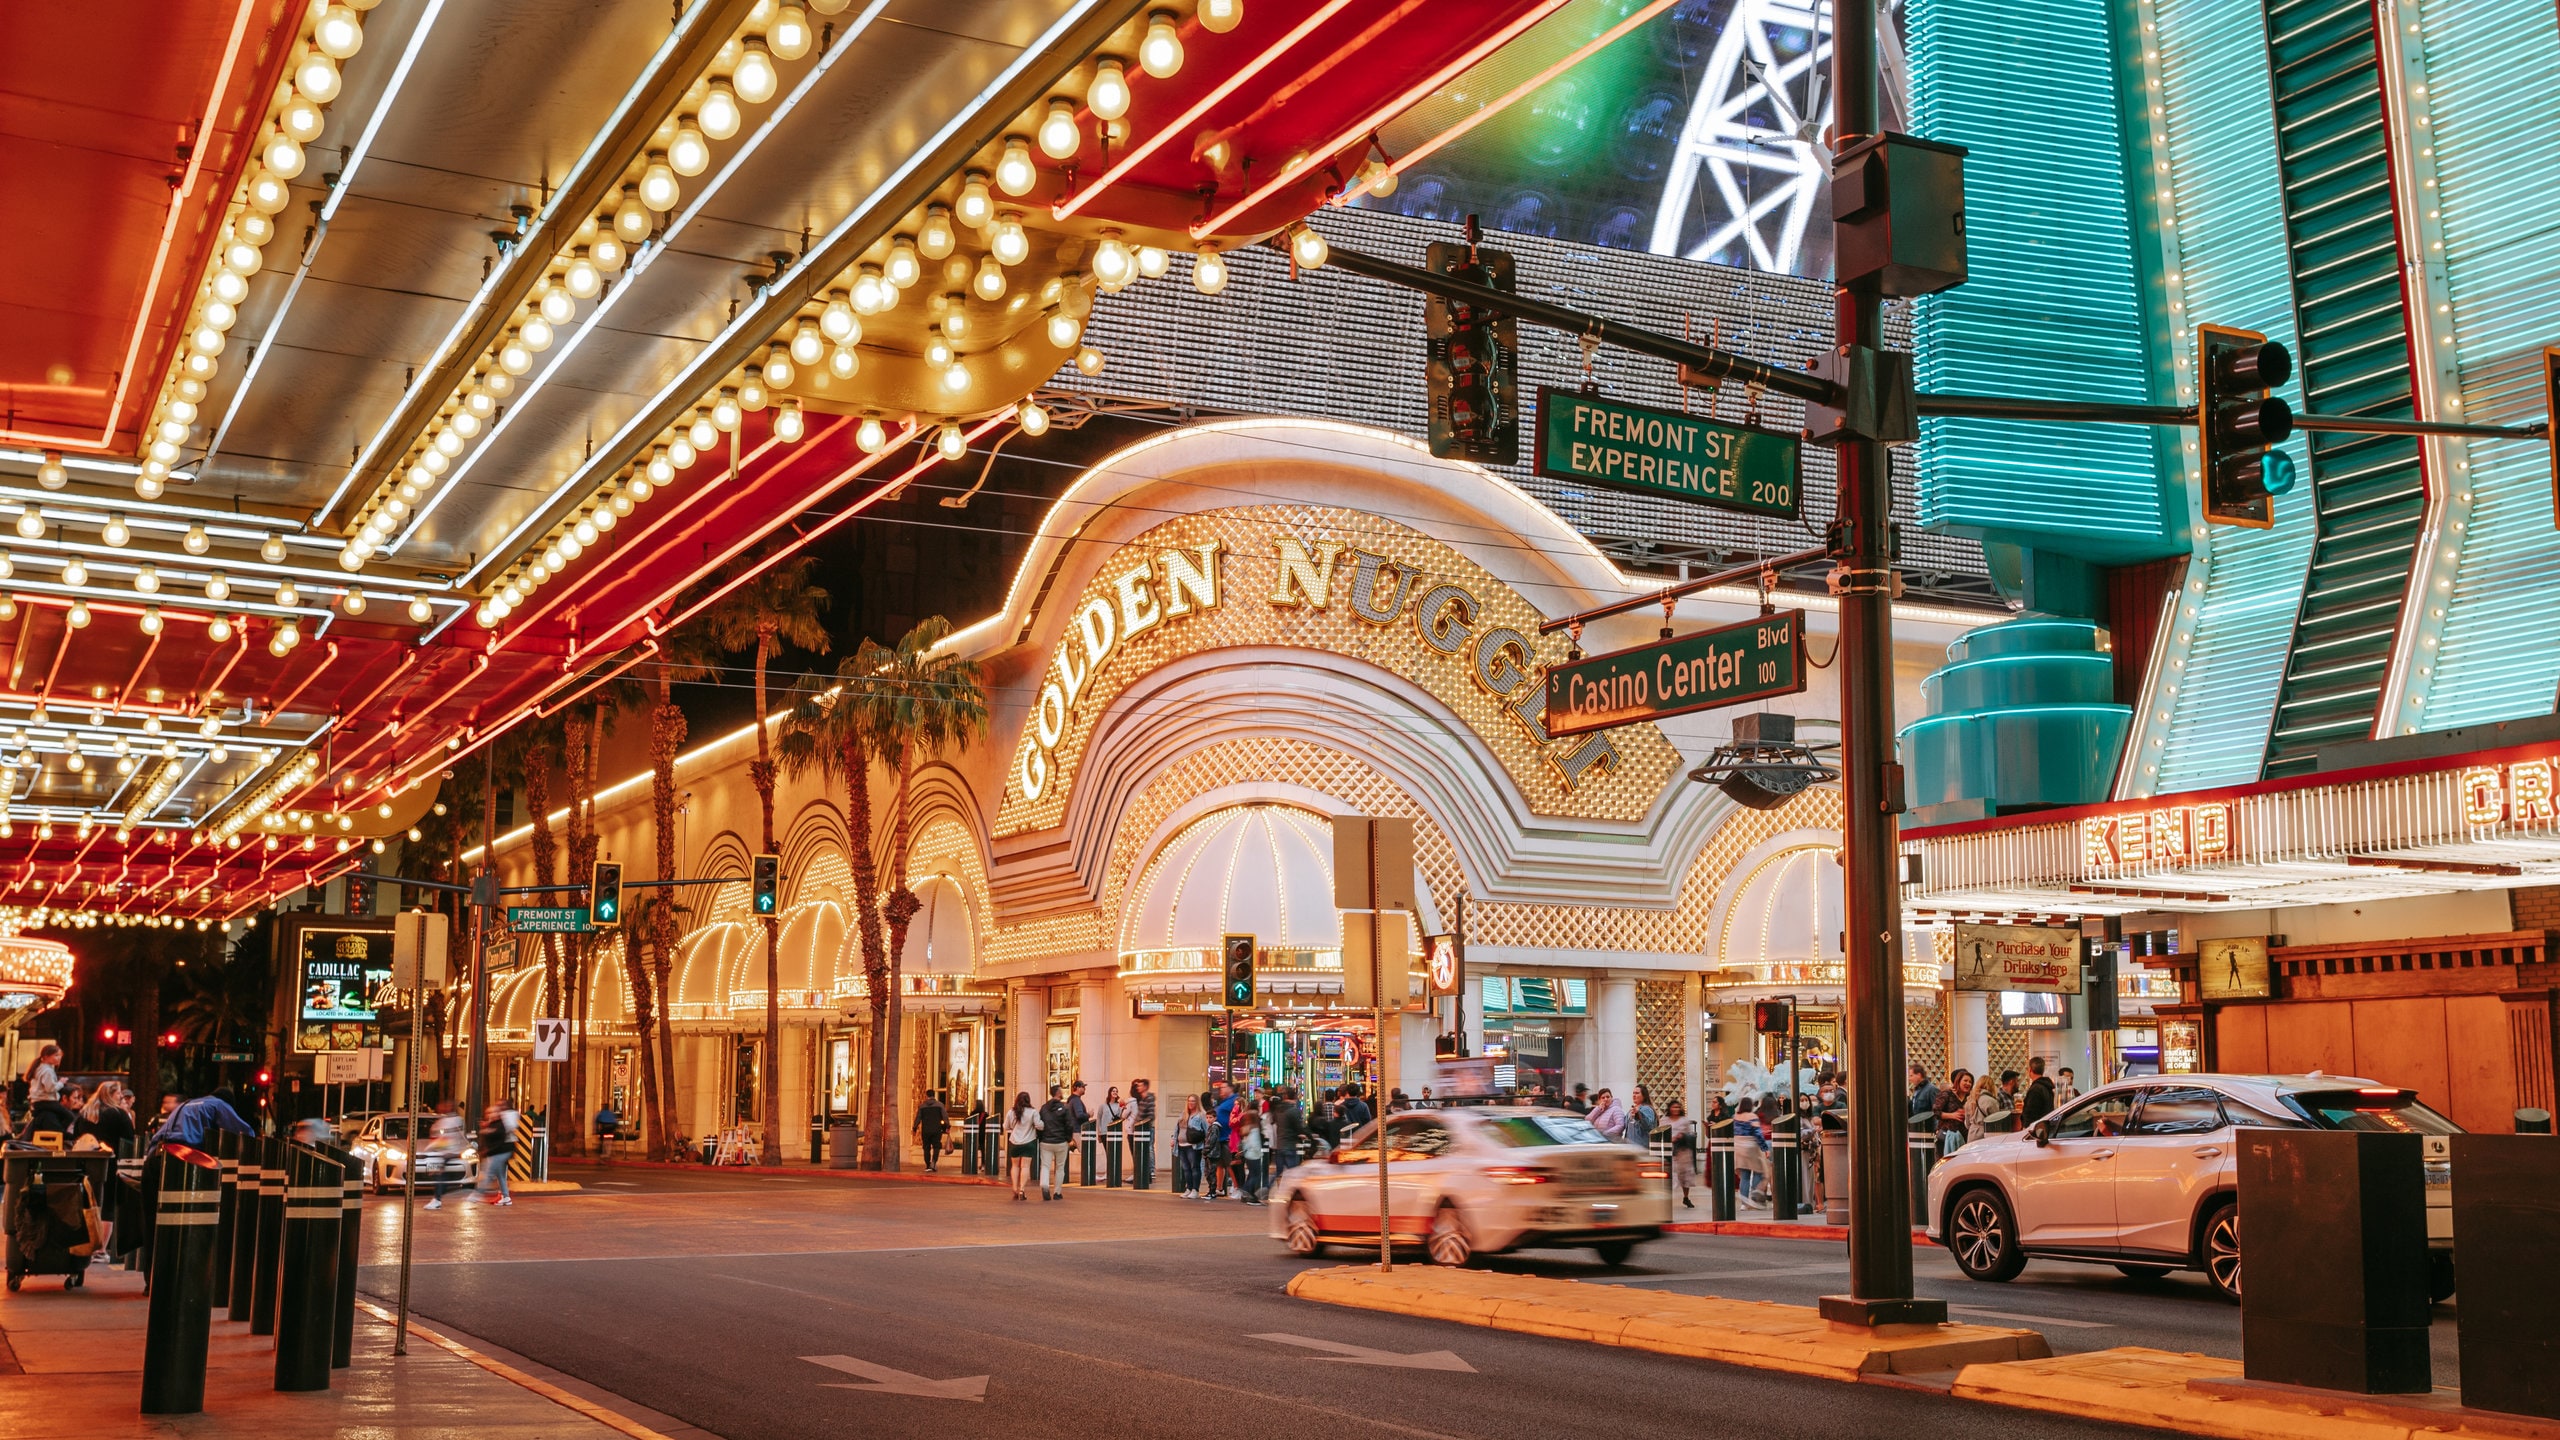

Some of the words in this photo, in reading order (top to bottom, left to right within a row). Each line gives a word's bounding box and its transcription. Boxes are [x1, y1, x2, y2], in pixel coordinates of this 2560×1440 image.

[1573, 405, 1699, 454] FREMONT
[1705, 430, 1735, 460] ST
[1571, 441, 1734, 498] EXPERIENCE
[1752, 480, 1790, 507] 200
[1757, 622, 1789, 649] Blvd
[1021, 538, 1224, 801] GOLDEN
[1552, 674, 1559, 693] S
[1569, 665, 1648, 716] Casino
[1656, 644, 1745, 700] Center
[1758, 660, 1776, 684] 100
[2461, 762, 2560, 826] CR
[2084, 803, 2229, 867] KENO
[518, 910, 562, 920] FREMONT
[564, 910, 576, 919] ST
[518, 921, 576, 930] EXPERIENCE
[1996, 940, 2045, 956] Purchase
[2048, 943, 2072, 959] Your
[308, 963, 360, 977] CADILLAC
[2003, 960, 2040, 974] Drinks
[2042, 962, 2068, 978] Here
[2026, 1017, 2045, 1025] TRIBUTE
[2045, 1016, 2059, 1025] BAND
